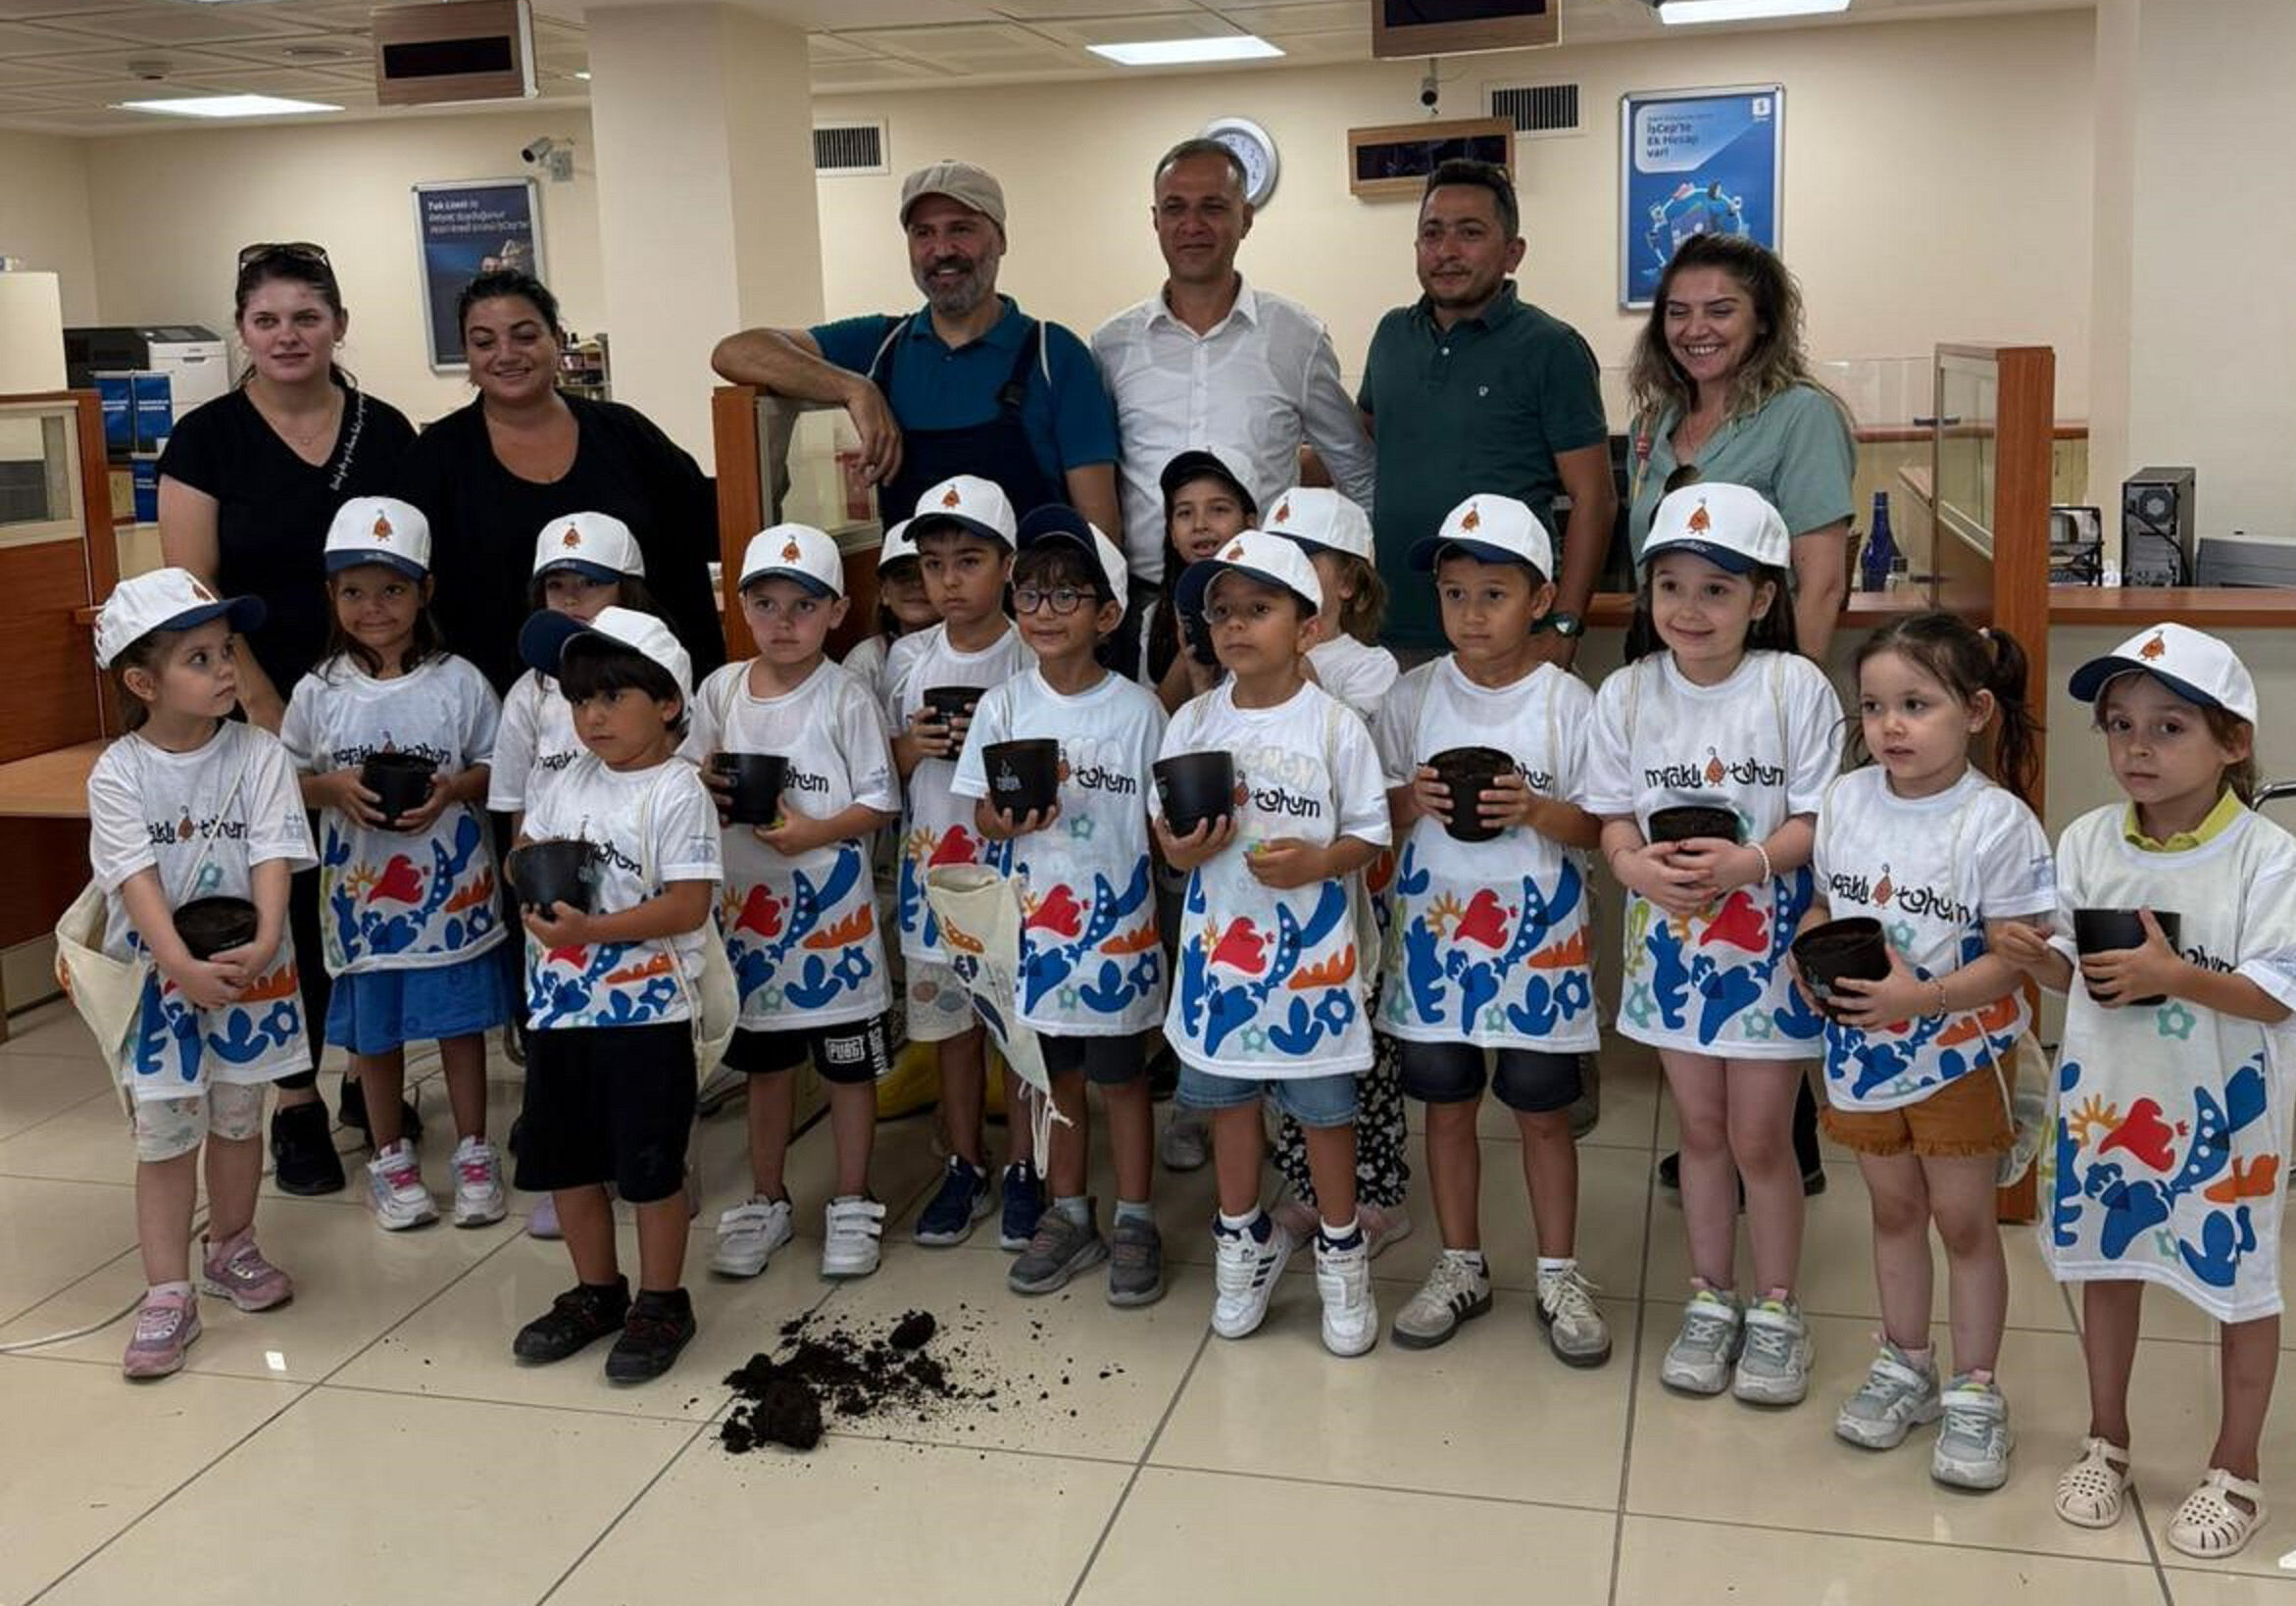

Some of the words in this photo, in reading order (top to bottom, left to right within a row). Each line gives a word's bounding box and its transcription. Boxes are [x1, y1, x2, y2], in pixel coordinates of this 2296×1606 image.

[784, 766, 829, 794] ohum
[1076, 764, 1137, 795] tohum
[1253, 786, 1321, 819] tohum
[829, 1040, 861, 1060] PUBG
